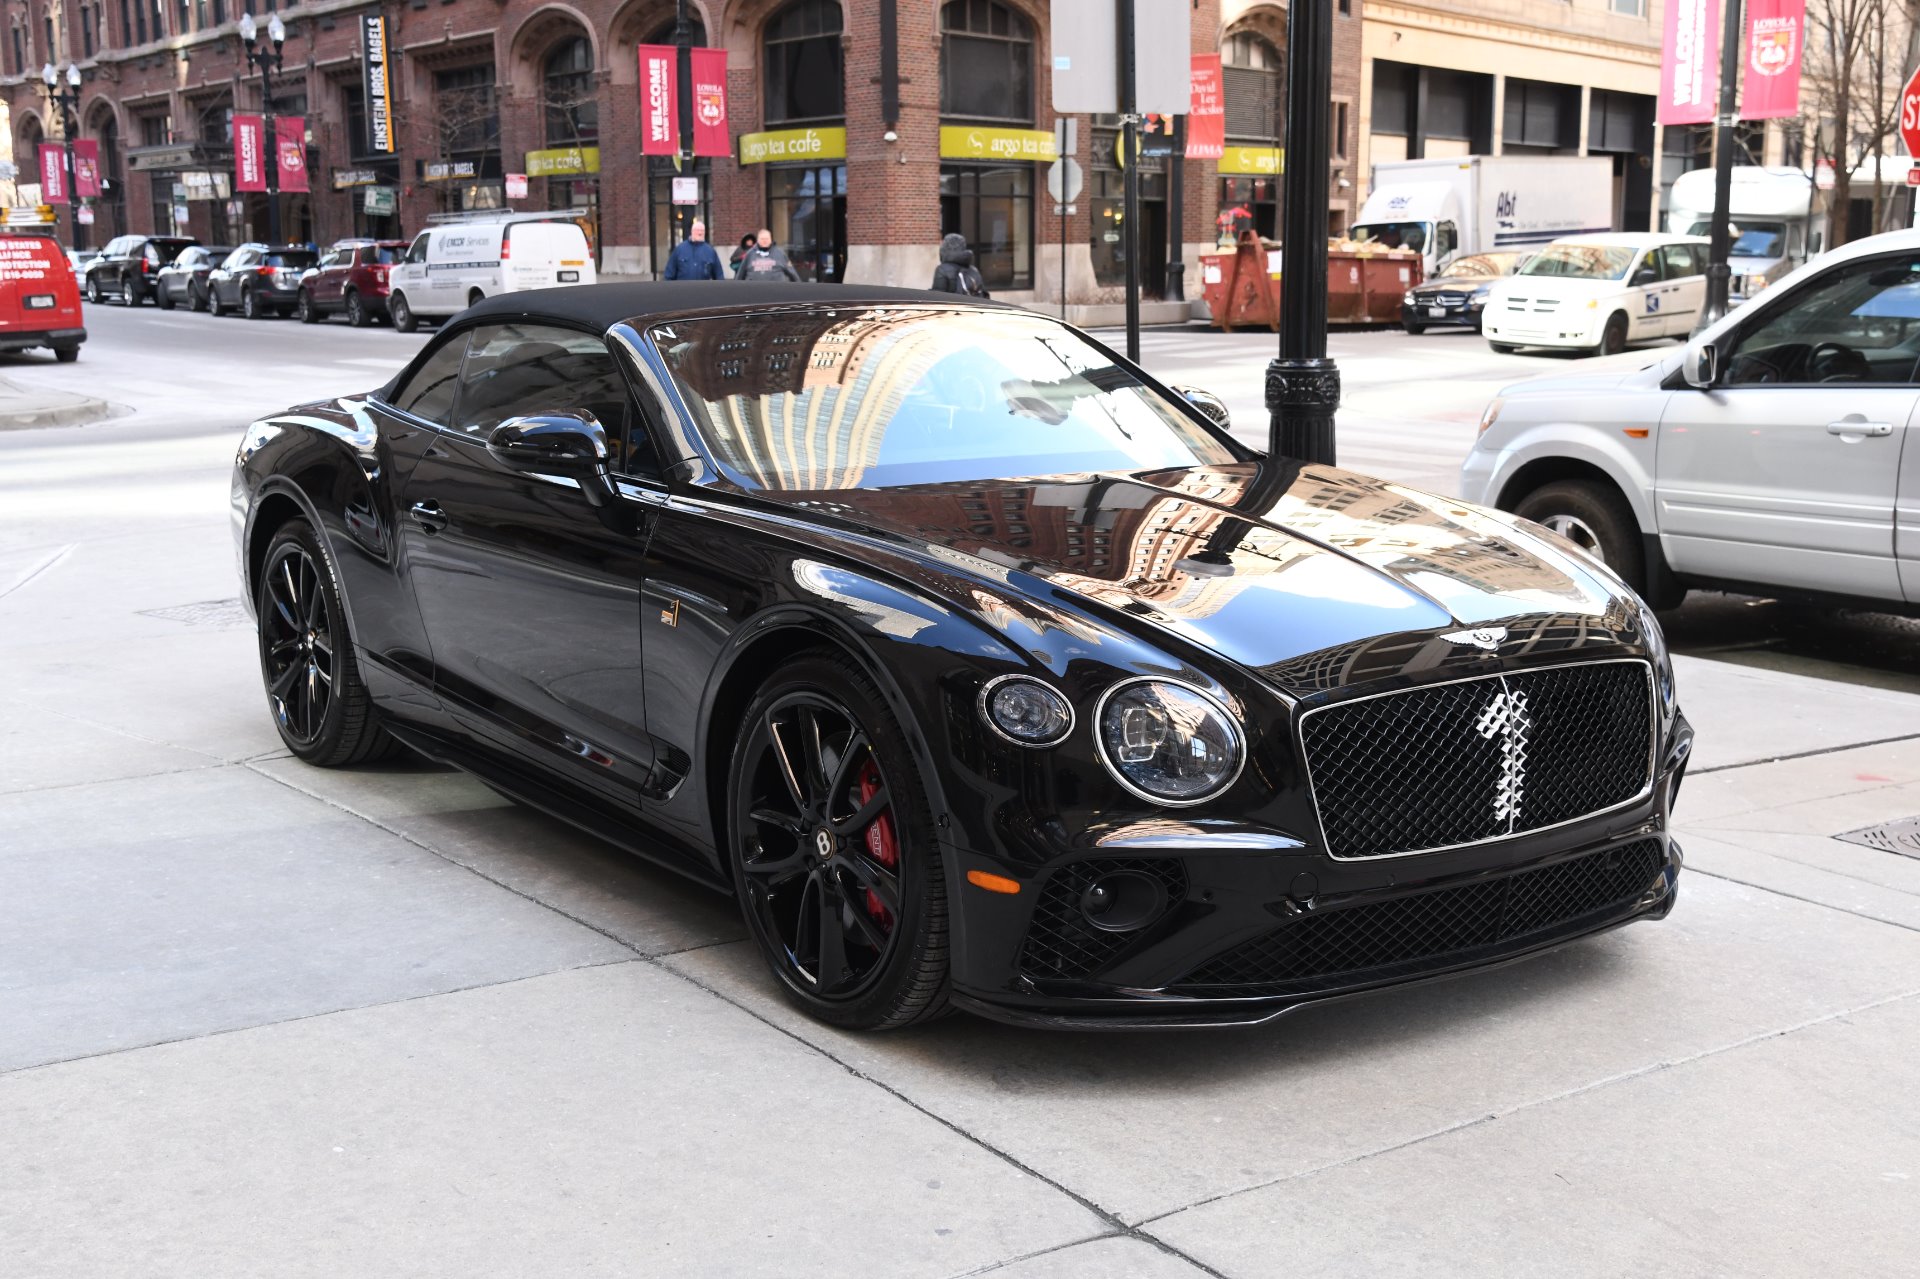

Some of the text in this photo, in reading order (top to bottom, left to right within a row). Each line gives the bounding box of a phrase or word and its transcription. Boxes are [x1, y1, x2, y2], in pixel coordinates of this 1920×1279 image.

[1753, 16, 1797, 30] LOYOLA
[367, 17, 383, 62] BAGELS
[649, 58, 663, 142] WELCOME
[696, 83, 724, 92] LOYOLA
[374, 98, 389, 150] EINSTEIN
[240, 125, 253, 182] WELCOME
[788, 130, 821, 153] café
[991, 138, 1020, 157] argo
[1022, 137, 1038, 153] tea
[1496, 190, 1517, 217] Abt
[0, 259, 51, 269] ROTECTION
